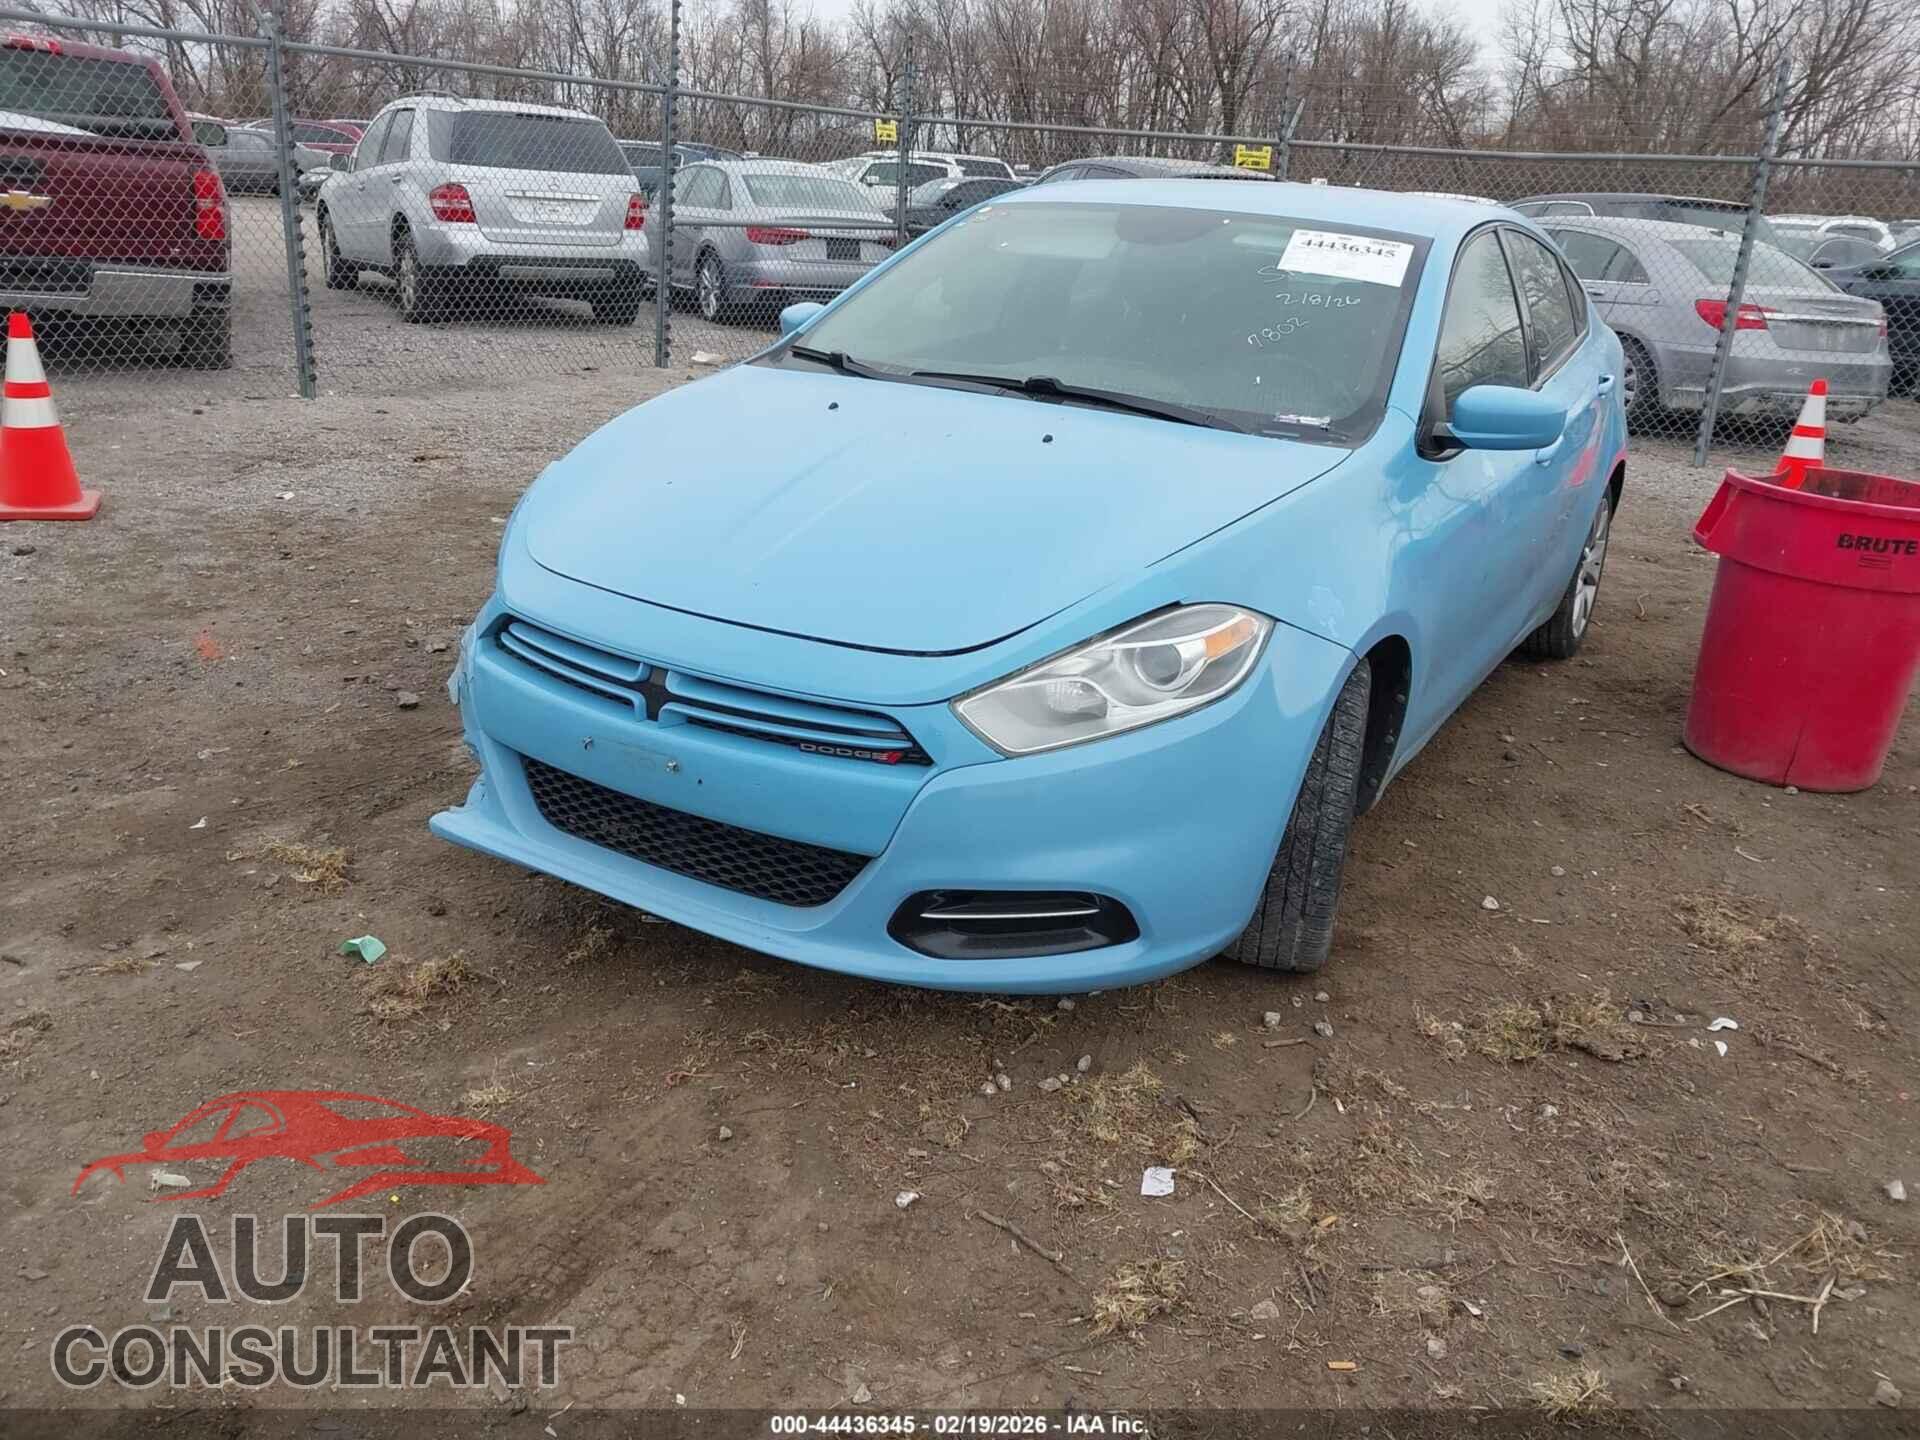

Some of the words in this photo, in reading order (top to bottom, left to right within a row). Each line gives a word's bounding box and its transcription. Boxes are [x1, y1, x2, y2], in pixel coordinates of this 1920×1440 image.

[1301, 239, 1396, 258] 44436345
[1837, 533, 1918, 555] BRUTE
[800, 743, 889, 761] DODGE
